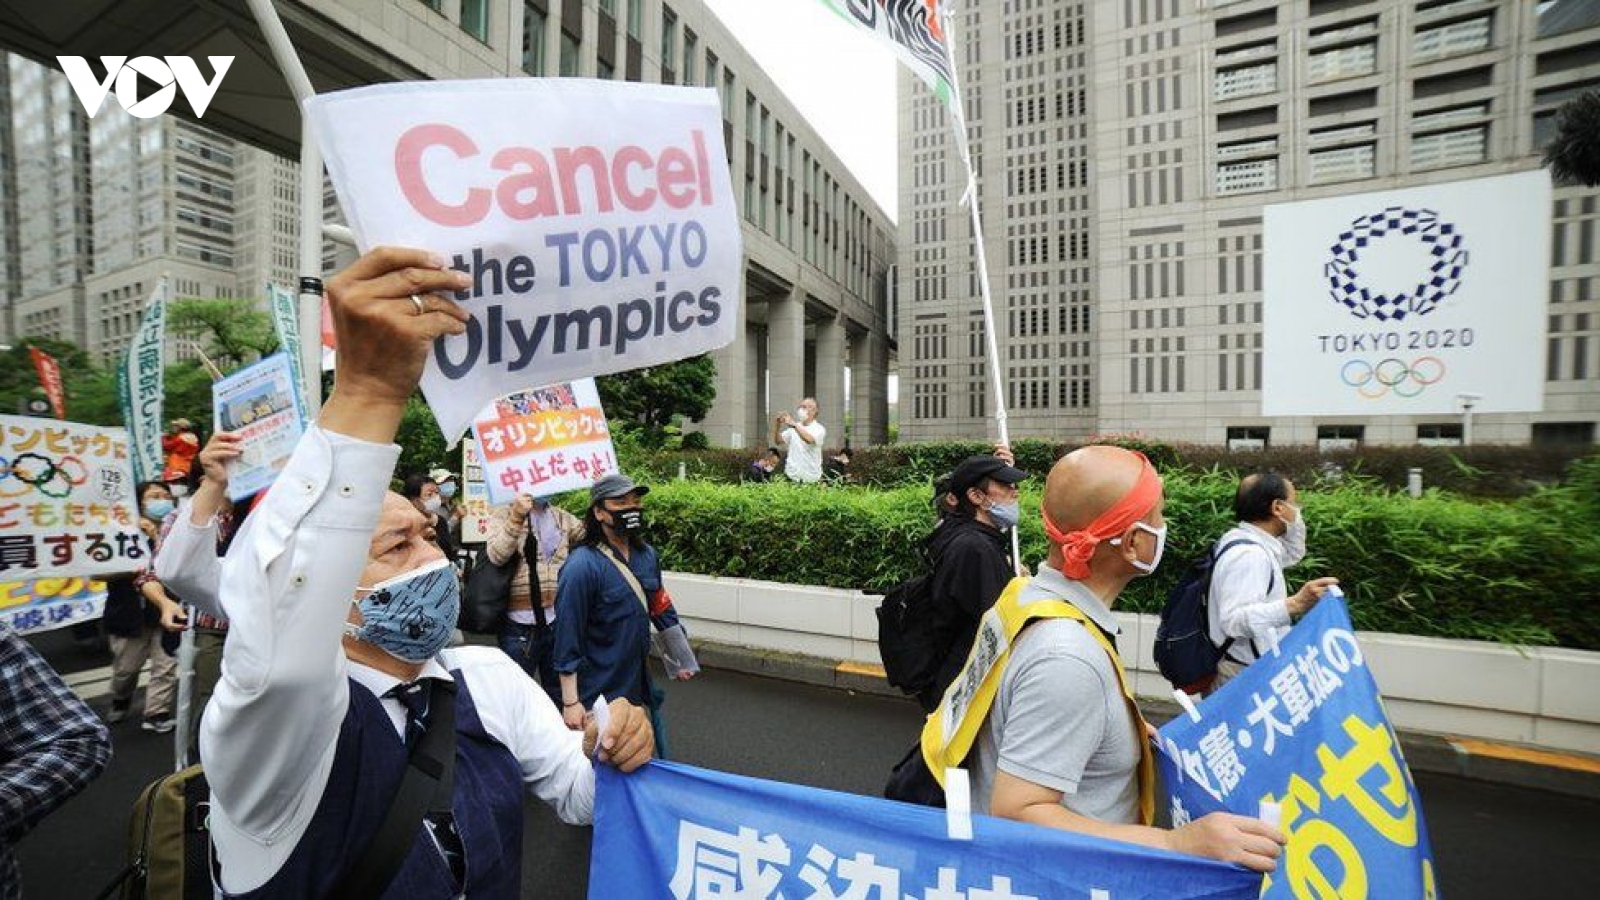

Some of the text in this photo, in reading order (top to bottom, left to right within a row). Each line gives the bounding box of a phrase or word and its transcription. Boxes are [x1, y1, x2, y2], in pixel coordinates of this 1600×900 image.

[394, 123, 713, 227] Cancel
[448, 220, 708, 301] the TOKYO
[434, 282, 721, 380] Olympics
[1318, 328, 1475, 353] TOKYO 2020
